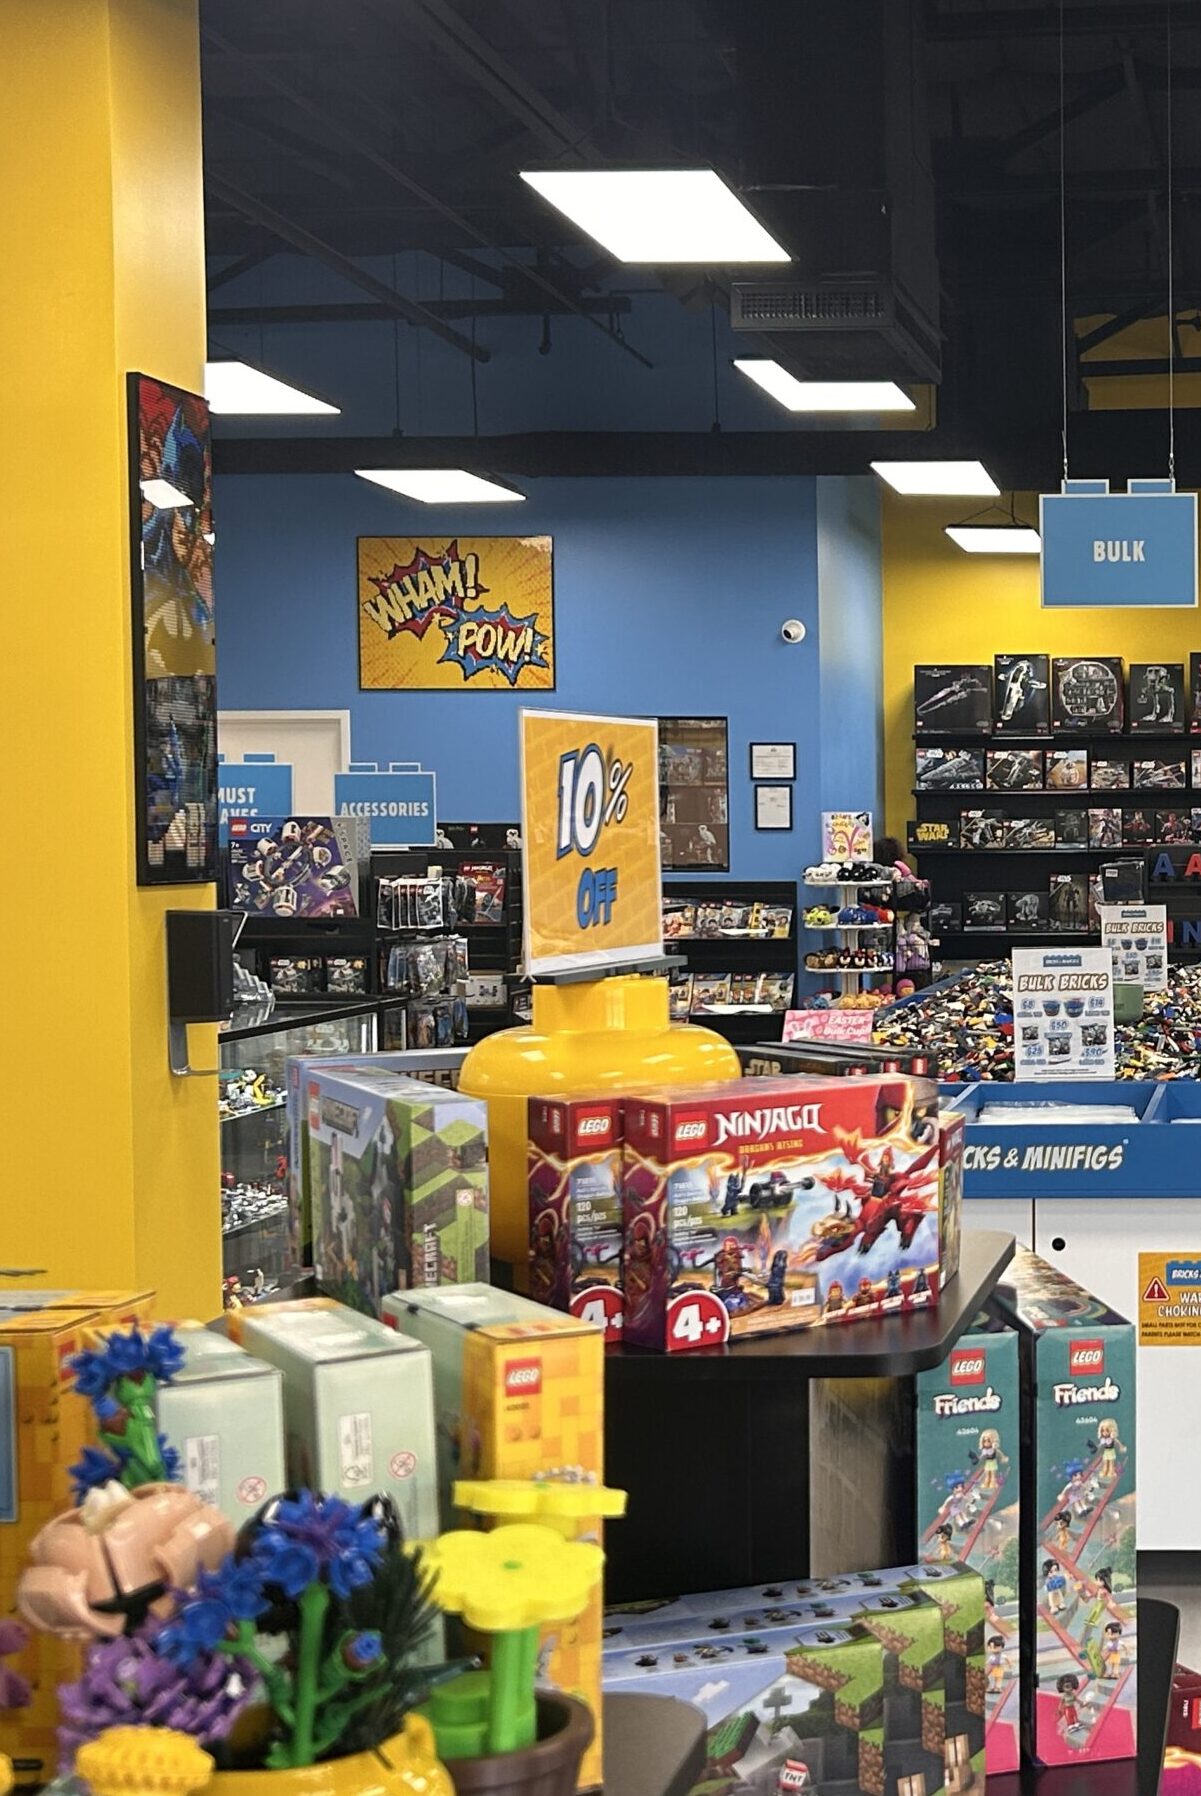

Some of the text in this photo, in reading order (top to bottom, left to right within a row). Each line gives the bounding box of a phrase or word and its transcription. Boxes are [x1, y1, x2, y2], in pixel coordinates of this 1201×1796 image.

[1093, 540, 1145, 562] BULK
[362, 553, 478, 632] WHAM!
[457, 621, 533, 662] POW!
[341, 802, 429, 817] ACCESSORIES
[251, 823, 272, 833] CITY
[577, 867, 618, 929] OFF
[1105, 922, 1164, 934] BULK BRICKS
[1018, 973, 1108, 992] BULK BRICKS
[829, 1015, 865, 1025] EASTER
[577, 1116, 610, 1135] LEGO
[675, 1121, 706, 1141] LEGO
[711, 1103, 829, 1147] NINJAGO
[963, 1144, 1123, 1171] CKS & MINIFIGS
[424, 1223, 438, 1286] ECRAFT
[1171, 1269, 1199, 1280] BRICKS
[672, 1304, 721, 1342] 4+
[1071, 1349, 1103, 1366] LEGO
[507, 1367, 540, 1386] LEGO
[952, 1359, 983, 1376] LEGO
[1053, 1377, 1120, 1404] Friends
[933, 1387, 1001, 1416] Friends
[784, 1771, 804, 1783] TNT
